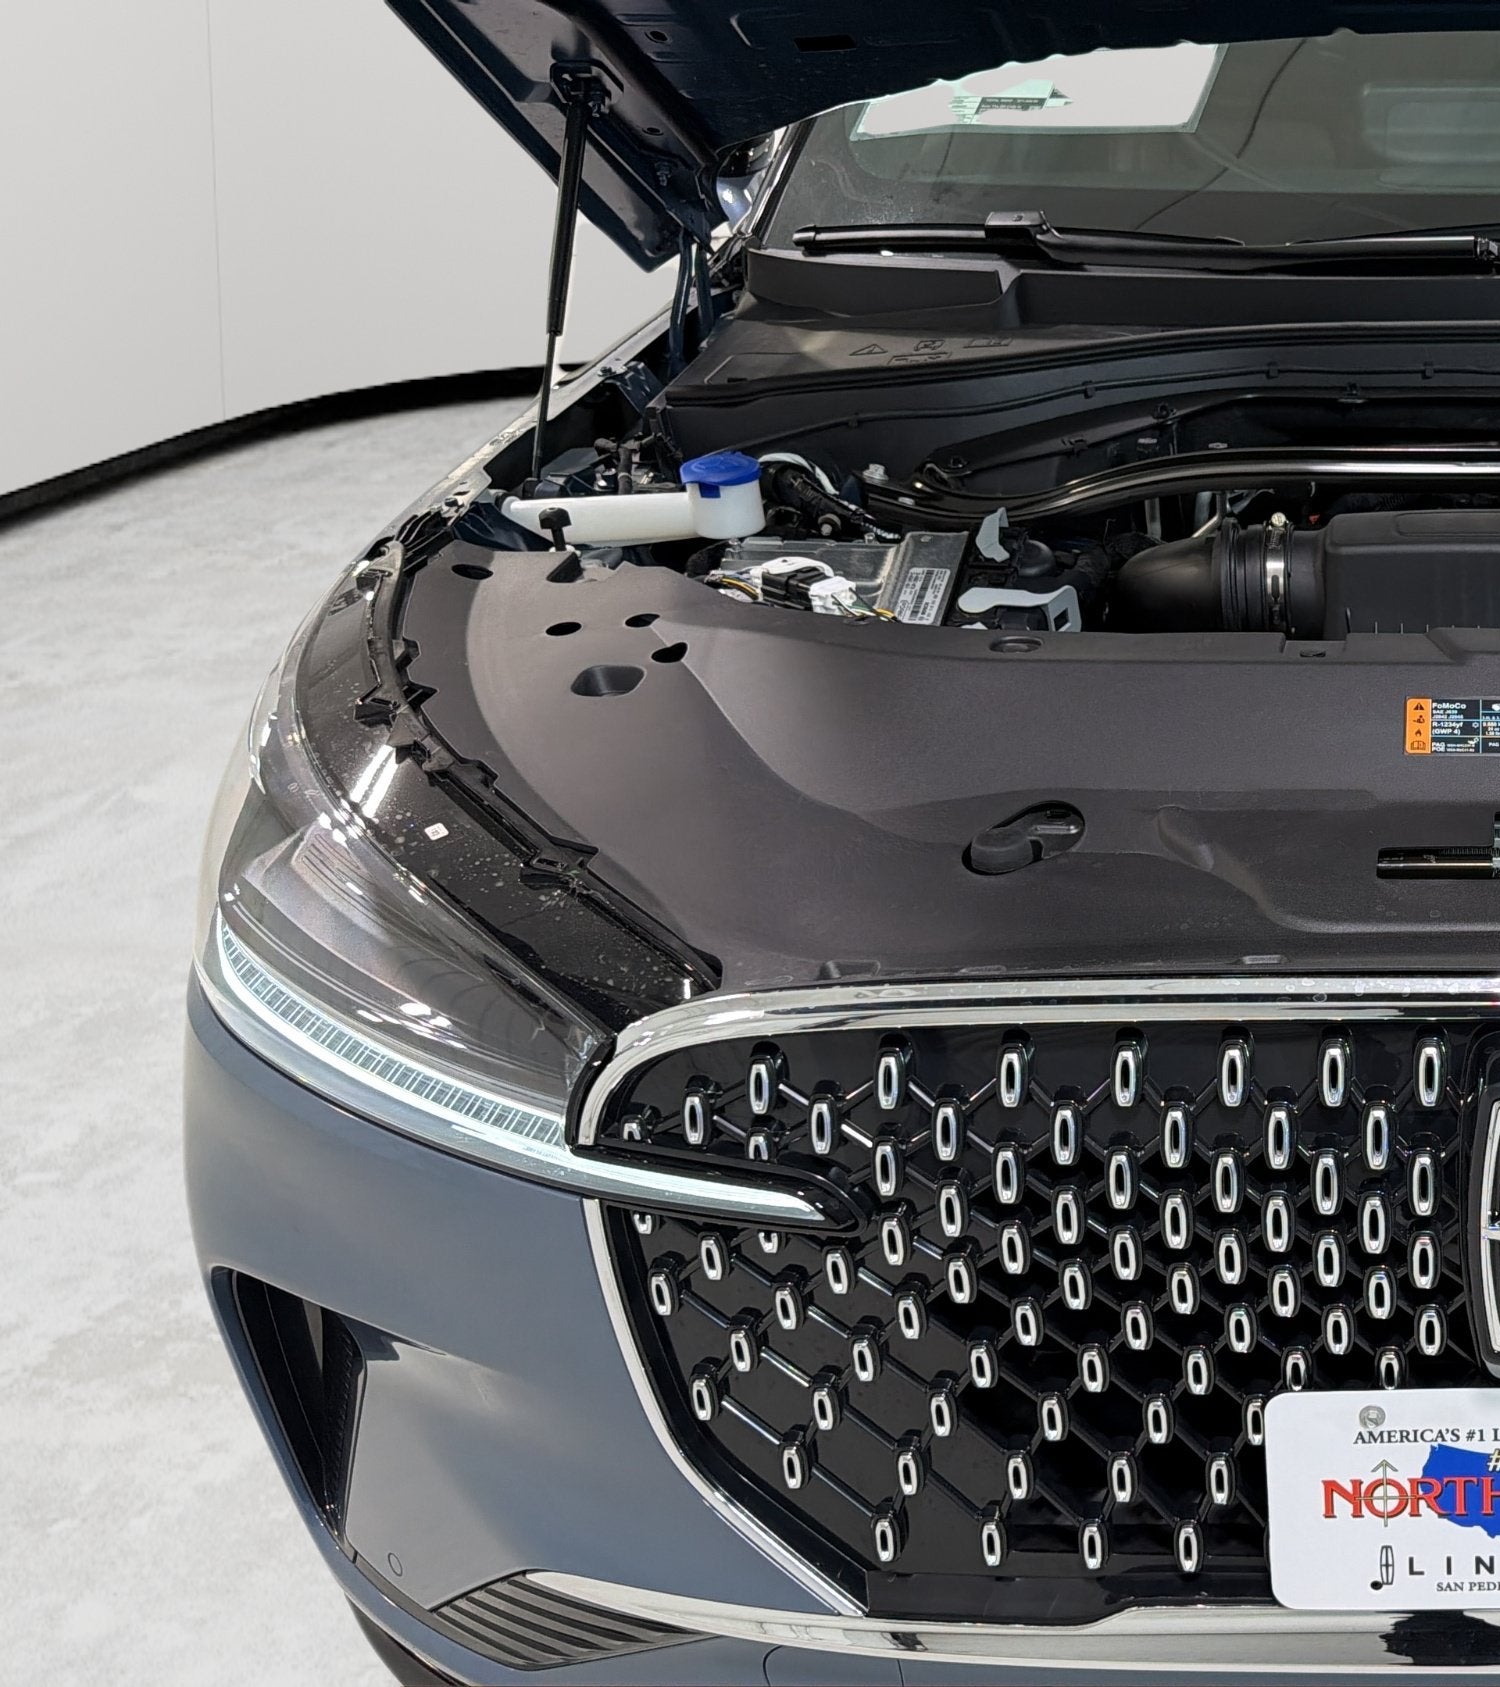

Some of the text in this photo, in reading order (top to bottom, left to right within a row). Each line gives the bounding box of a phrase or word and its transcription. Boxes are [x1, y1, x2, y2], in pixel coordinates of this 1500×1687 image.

[1353, 1428, 1461, 1445] AMERICA'S
[1465, 1428, 1486, 1443] #1
[1436, 1581, 1464, 1592] SAN
